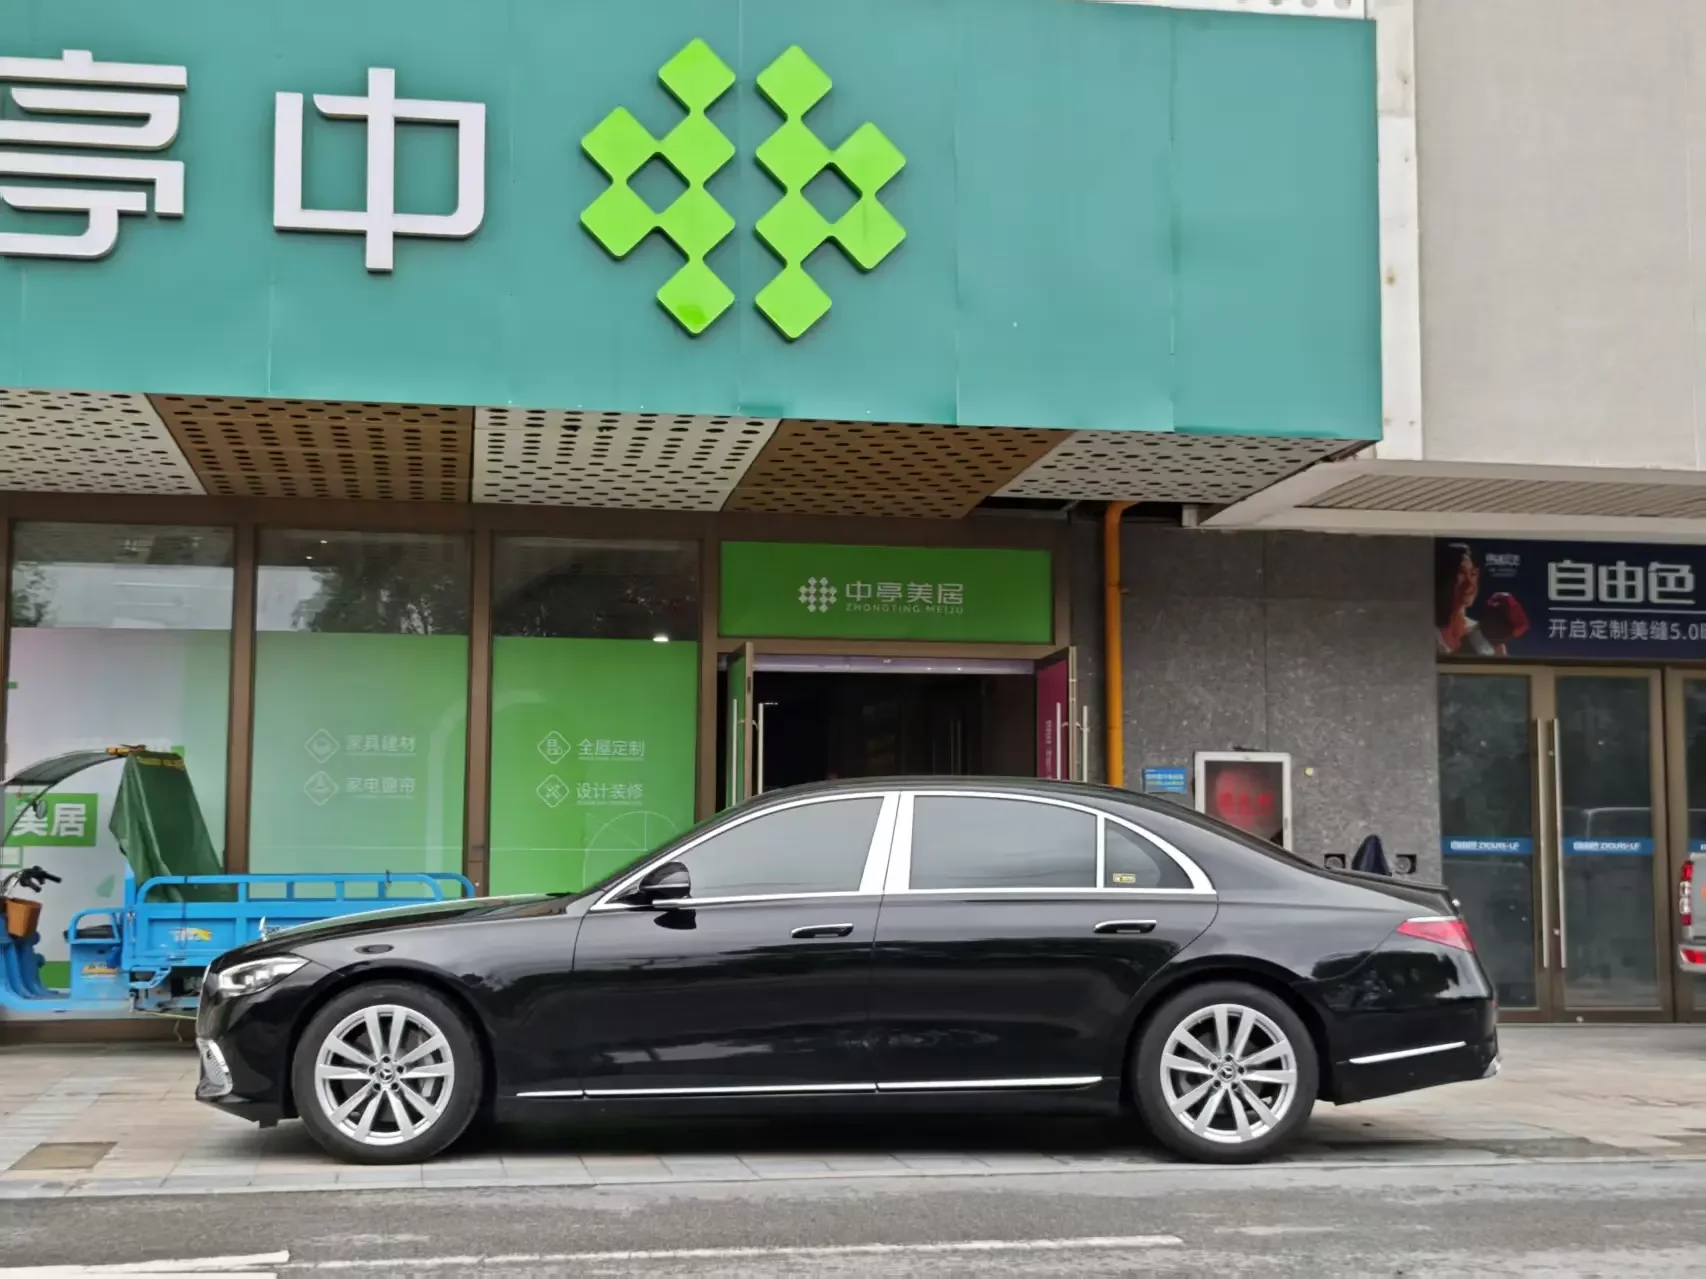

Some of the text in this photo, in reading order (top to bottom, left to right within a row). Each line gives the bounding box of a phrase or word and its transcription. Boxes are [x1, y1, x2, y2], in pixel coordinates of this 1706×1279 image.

[1548, 560, 1695, 604] 自由色
[845, 580, 964, 605] 中亭美居
[845, 603, 921, 614] ZHONGTING
[1548, 618, 1706, 640] 开启定制美缝5.0
[576, 738, 645, 756] 全屋定制
[576, 782, 644, 800] 设计装修
